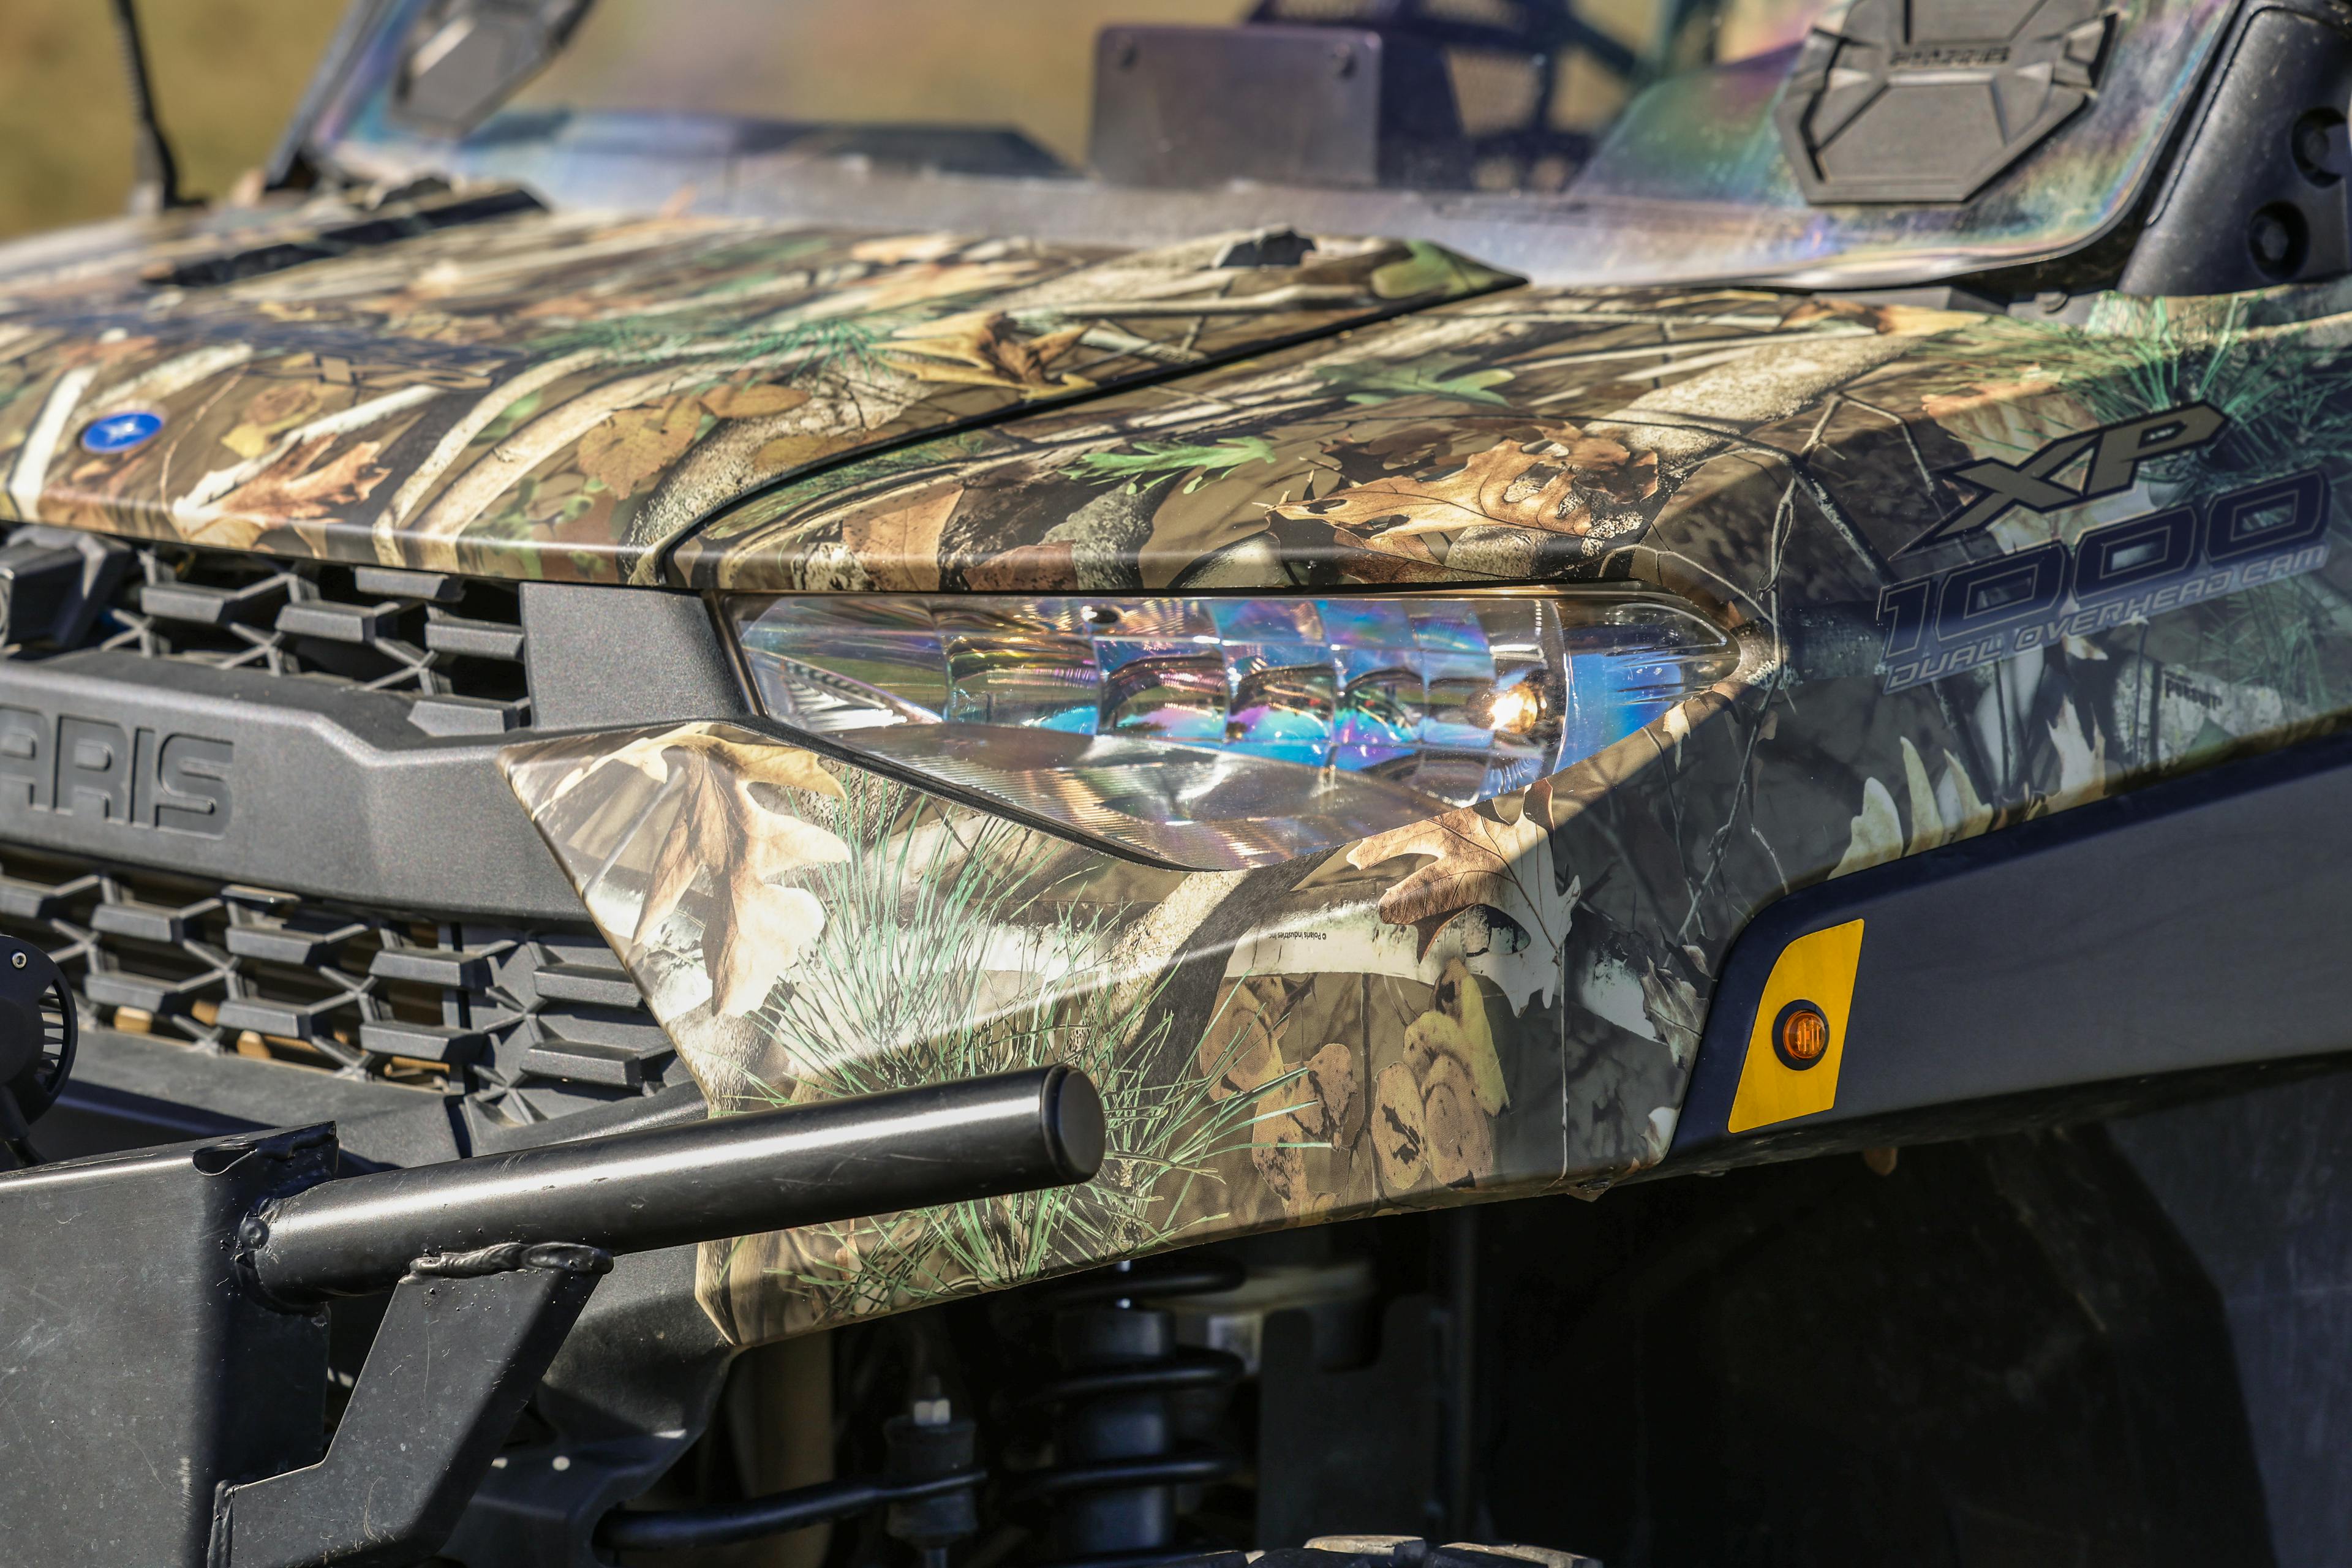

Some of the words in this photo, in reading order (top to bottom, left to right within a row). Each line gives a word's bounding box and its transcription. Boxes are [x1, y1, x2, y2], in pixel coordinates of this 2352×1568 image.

[1888, 400, 2230, 560] XP
[1879, 470, 2329, 658] 1000
[1890, 639, 2002, 688] DUAL
[2015, 572, 2233, 650] OVERHEAD
[2242, 545, 2324, 584] CAM
[1278, 931, 1303, 940] Industries
[1303, 932, 1321, 940] Polaris
